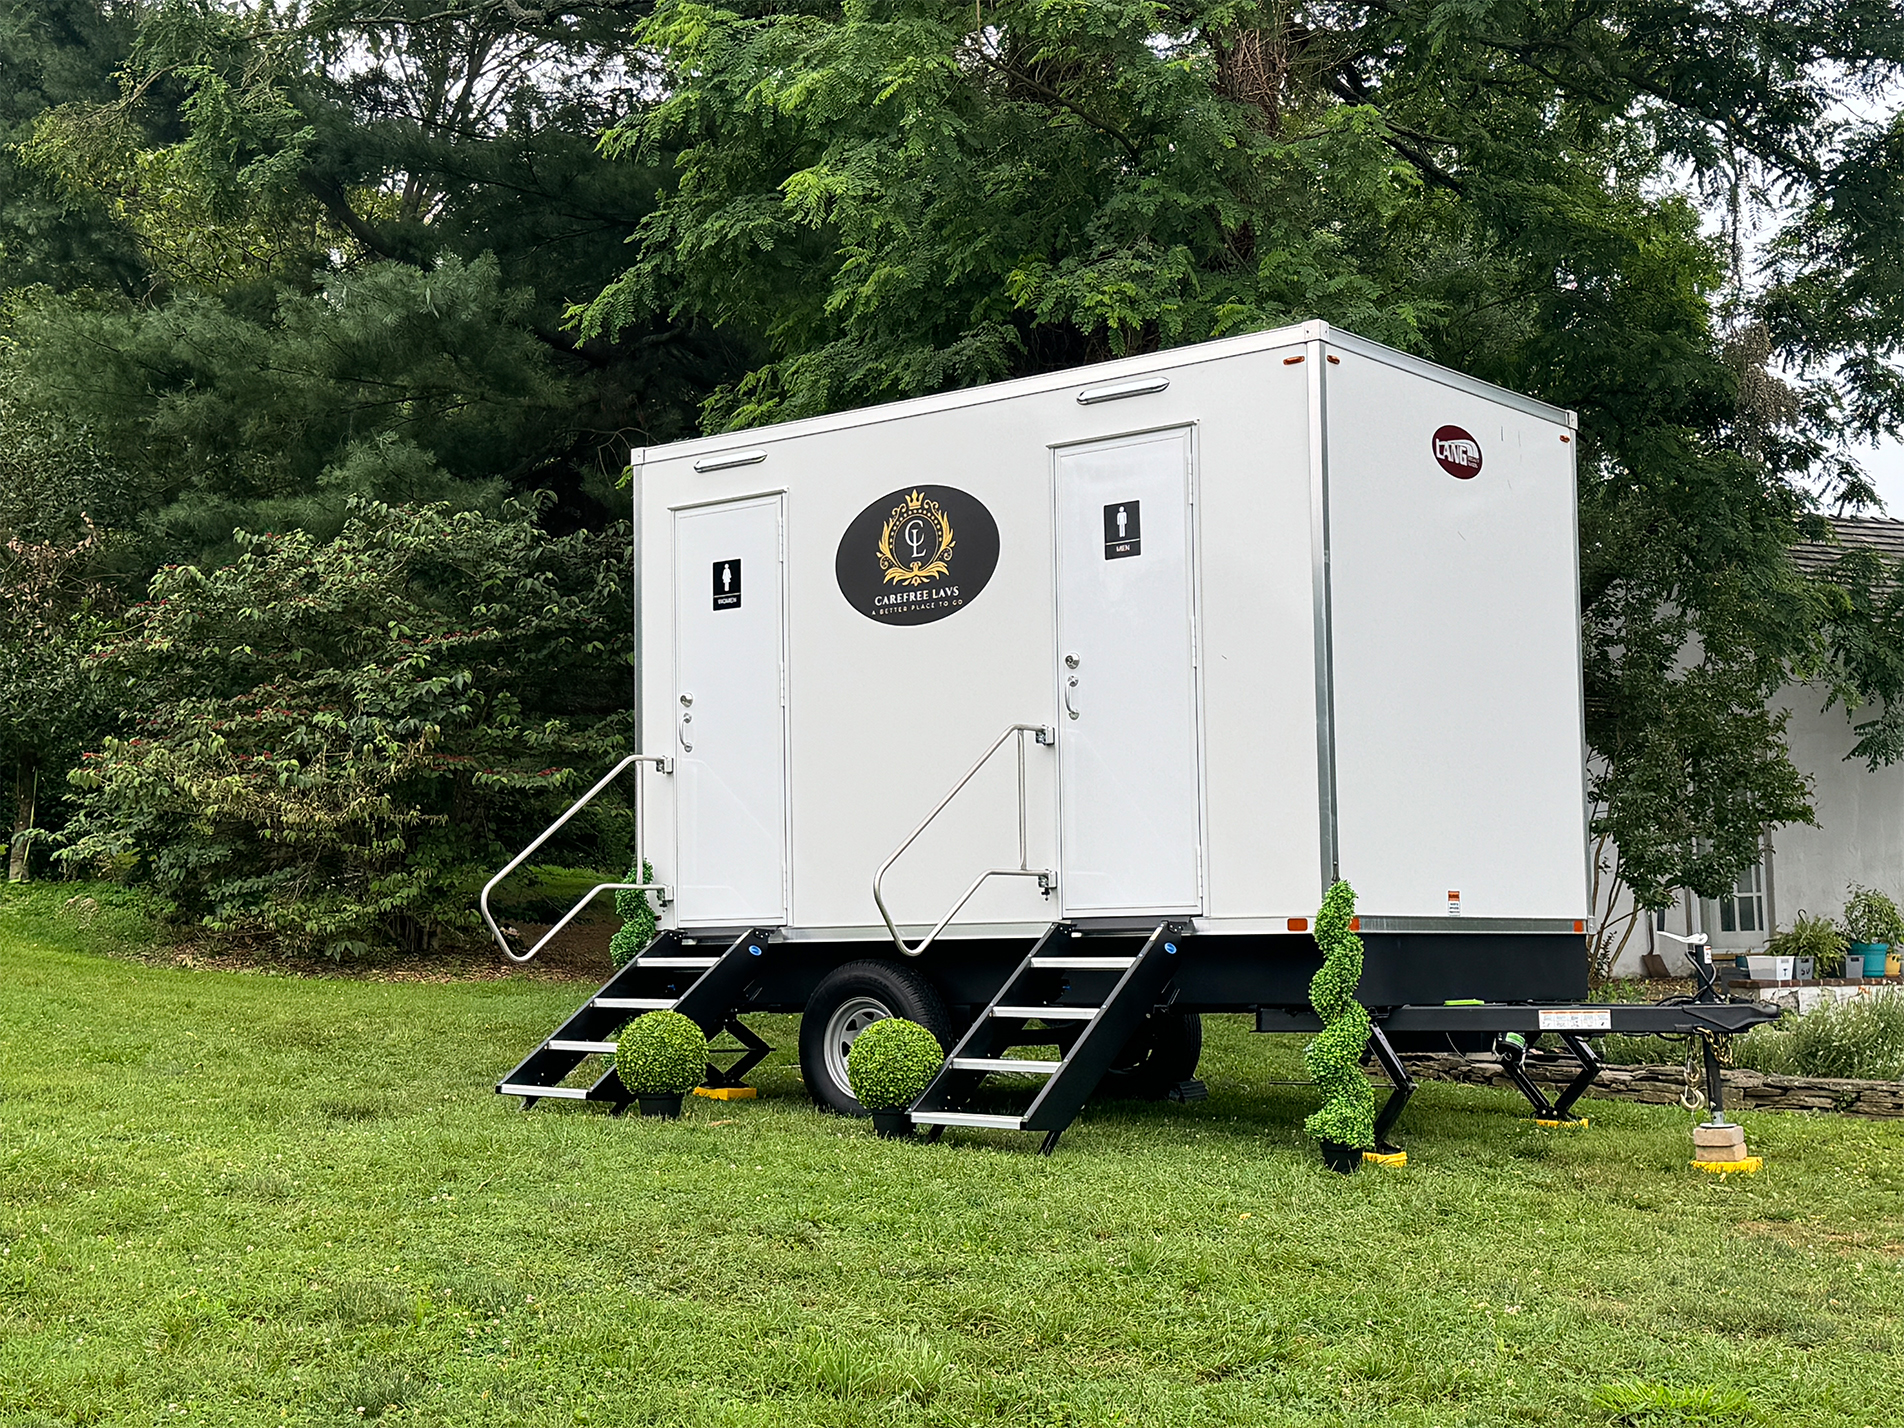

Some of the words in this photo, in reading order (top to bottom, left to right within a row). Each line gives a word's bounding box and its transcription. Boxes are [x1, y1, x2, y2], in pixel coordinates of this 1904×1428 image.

[1435, 438, 1468, 466] LANG
[1116, 544, 1130, 552] MEN
[717, 597, 737, 605] WOMEN
[874, 590, 929, 606] CAREFREE
[932, 585, 960, 599] LAVS
[879, 605, 908, 615] BETTER
[911, 602, 936, 611] PLACE
